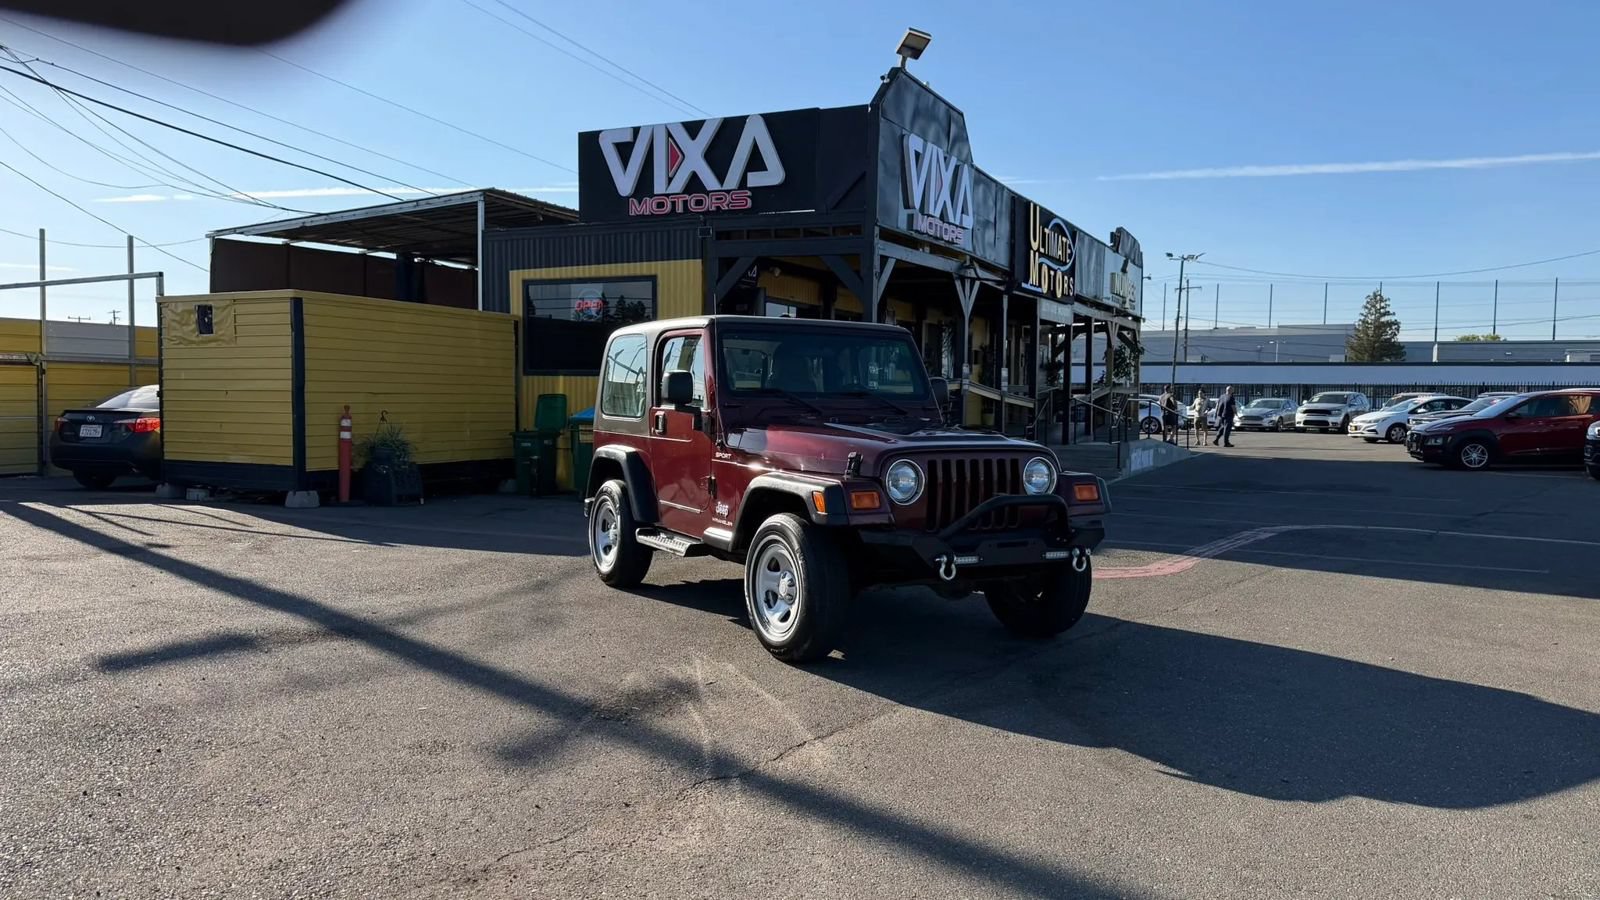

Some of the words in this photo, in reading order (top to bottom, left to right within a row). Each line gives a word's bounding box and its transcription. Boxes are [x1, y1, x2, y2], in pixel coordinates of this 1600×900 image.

[599, 114, 785, 197] VIXA
[629, 190, 752, 216] MOTORS
[907, 133, 974, 229] VIXA
[915, 214, 964, 244] MOTORS
[1030, 202, 1071, 263] ULTIMATE
[1029, 249, 1074, 299] MOTORS
[715, 501, 729, 519] Jeep
